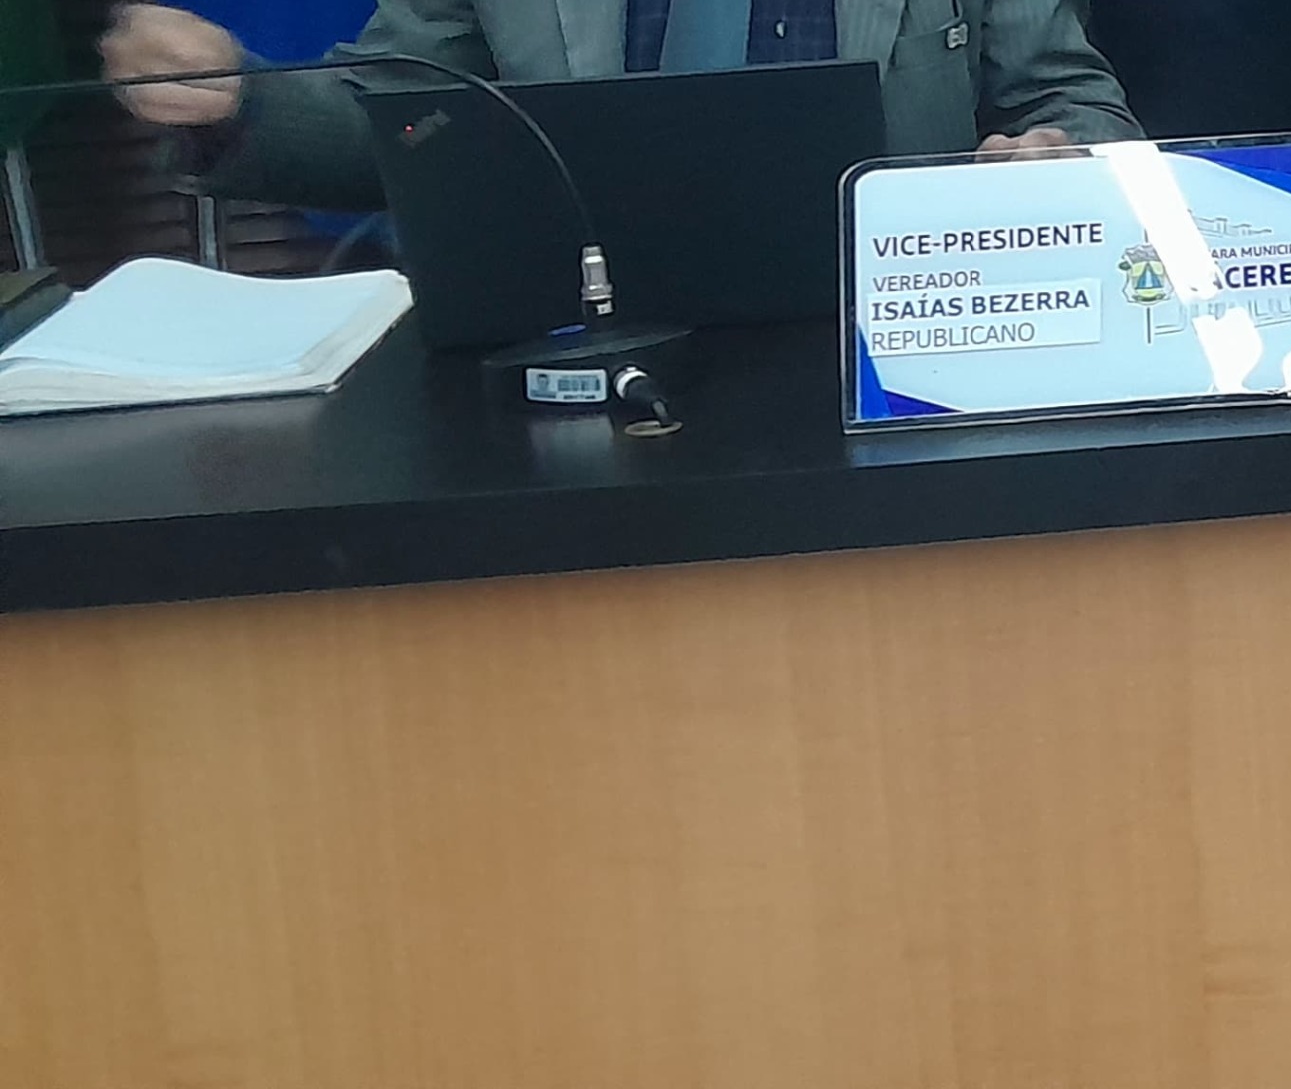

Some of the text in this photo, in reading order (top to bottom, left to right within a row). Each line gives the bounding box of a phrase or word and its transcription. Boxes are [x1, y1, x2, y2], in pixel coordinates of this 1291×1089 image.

[872, 222, 1104, 258] VICE-PRESIDENTE
[872, 269, 982, 293] VEREADOR
[871, 288, 1091, 322] ISAÍAS BEZERRA
[871, 322, 1036, 352] REPUBLICANO
